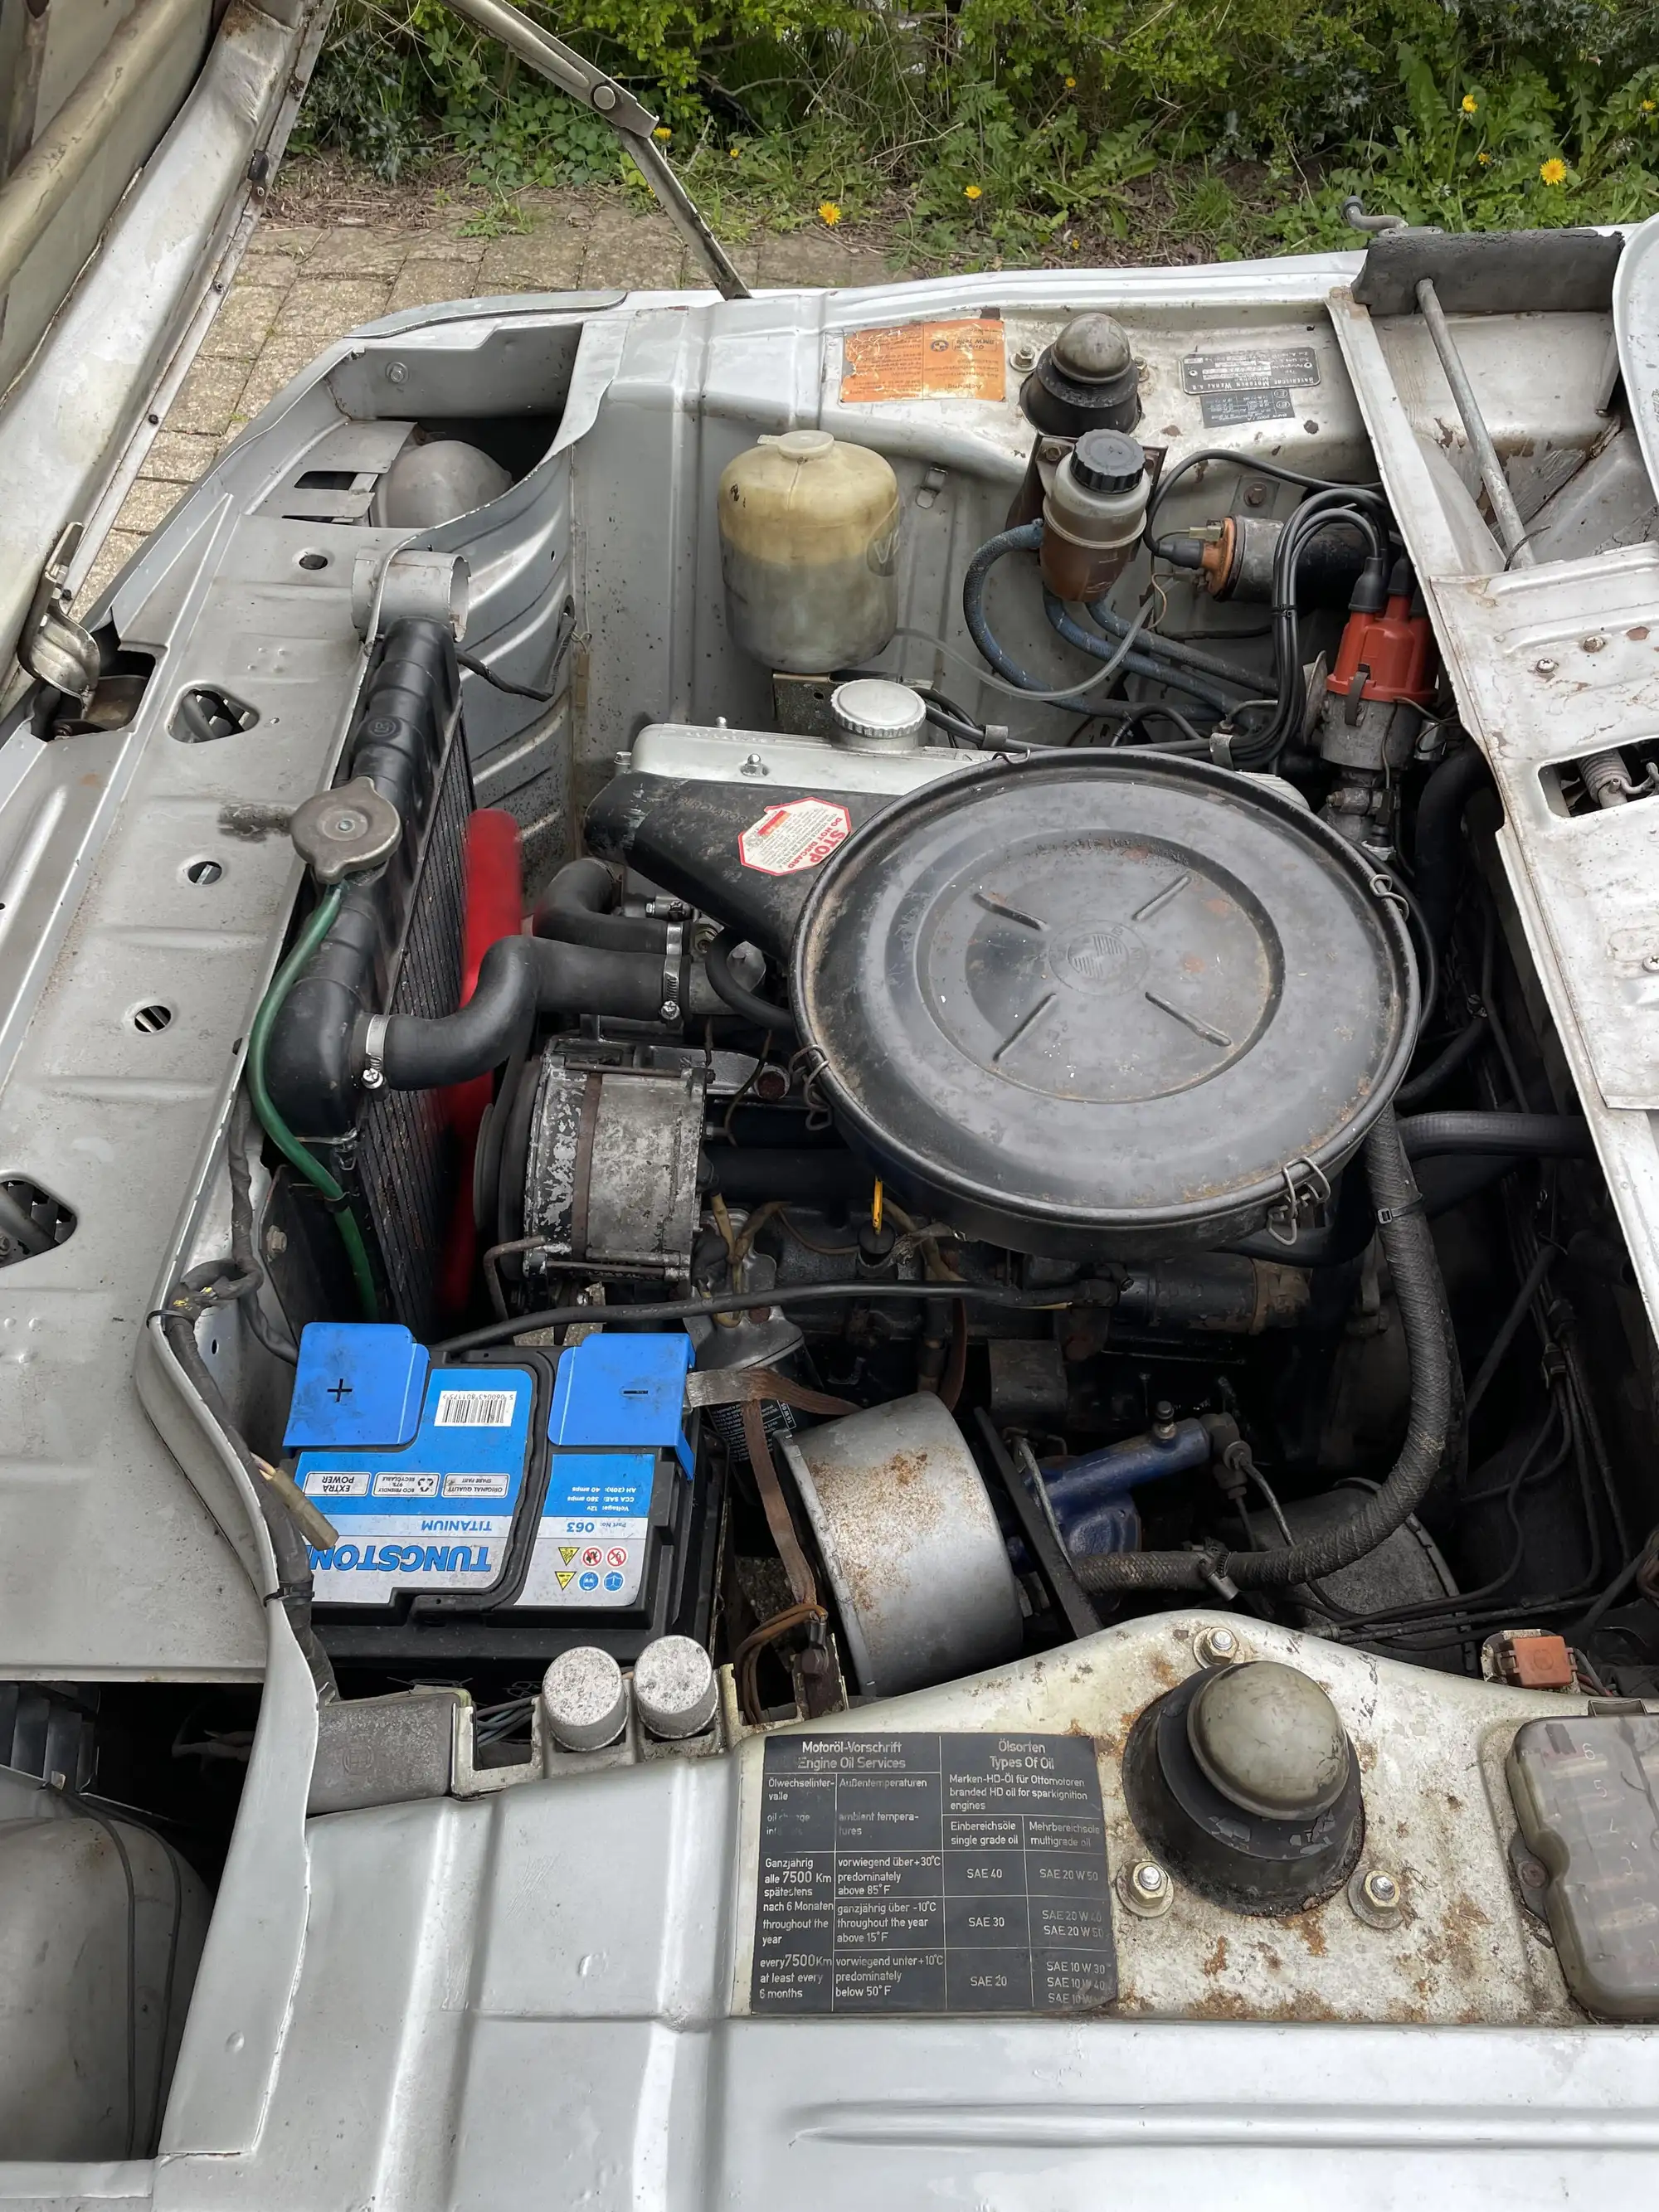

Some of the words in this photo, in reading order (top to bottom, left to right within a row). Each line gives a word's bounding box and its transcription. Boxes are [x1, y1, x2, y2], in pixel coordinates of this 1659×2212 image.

[830, 817, 843, 827] DO
[817, 826, 833, 841] NOT
[809, 829, 846, 863] STOP
[787, 841, 818, 868] DISCARD
[321, 1475, 355, 1484] POWER
[322, 1484, 351, 1493] EXTRA
[421, 1519, 492, 1532] TITANIUM
[304, 1544, 492, 1573] TUNGSTON
[802, 1741, 902, 1753] Motoröl-Vorschrift
[998, 1738, 1046, 1753] Ölsorten
[798, 1757, 837, 1772] Engine
[839, 1757, 854, 1768] Oil
[857, 1757, 906, 1769] Services
[989, 1755, 1023, 1771] Types
[1024, 1756, 1039, 1768] Of
[1039, 1757, 1055, 1770] Oil
[768, 1777, 835, 1788] Ölwechselinter-
[839, 1777, 927, 1789] Außentemperaturen
[949, 1772, 1014, 1784] Marken-HD-Öl
[1016, 1774, 1029, 1784] für
[1030, 1775, 1085, 1787] Ottomotoren
[950, 1787, 987, 1796] branded
[990, 1787, 1004, 1796] HD
[1005, 1787, 1016, 1796] oil
[1018, 1787, 1030, 1796] for
[950, 1800, 986, 1812] engines
[839, 1812, 875, 1821] ambient
[877, 1811, 919, 1823] tempera-
[839, 1826, 863, 1836] tures
[951, 1820, 1016, 1831] Einbereichsöle
[951, 1835, 978, 1847] single
[980, 1836, 1006, 1847] grade
[1008, 1834, 1019, 1845] oil
[1030, 1836, 1078, 1848] multigrade
[1081, 1837, 1092, 1847] oil
[765, 1857, 814, 1870] Ganzjährig
[837, 1856, 891, 1869] vorwiegend
[764, 1873, 781, 1884] alle
[782, 1870, 812, 1884] 7500
[815, 1873, 832, 1884] Km
[837, 1870, 902, 1885] predominately
[966, 1868, 989, 1879] SAE
[990, 1868, 1003, 1879] 40
[1039, 1869, 1061, 1879] SAE
[1063, 1869, 1073, 1880] 20
[1087, 1871, 1099, 1881] 50
[837, 1884, 864, 1895] above
[763, 1902, 785, 1912] nach
[786, 1901, 793, 1911] 6
[794, 1900, 834, 1912] Monaten
[837, 1902, 887, 1916] ganzjährig
[888, 1902, 910, 1913] über
[1041, 1909, 1064, 1920] SAE
[1065, 1910, 1078, 1922] 20
[762, 1918, 812, 1932] throughout
[814, 1918, 829, 1928] the
[837, 1918, 888, 1932] throughout
[890, 1917, 906, 1928] the
[907, 1918, 928, 1930] year
[968, 1917, 990, 1928] SAE
[993, 1917, 1005, 1928] 30
[1043, 1924, 1066, 1936] SAE
[1068, 1926, 1079, 1937] 20
[761, 1934, 783, 1947] year
[836, 1932, 864, 1943] above
[835, 1955, 891, 1969] vorwiegend
[1046, 1961, 1068, 1972] SAE
[1070, 1962, 1080, 1972] 10
[1093, 1963, 1106, 1975] 30
[760, 1972, 771, 1984] at
[771, 1972, 795, 1983] least
[797, 1973, 824, 1985] every
[835, 1970, 902, 1983] predominately
[970, 1976, 993, 1987] SAE
[995, 1974, 1008, 1987] 20
[1047, 1976, 1069, 1988] SAE
[1071, 1977, 1081, 1989] 10
[1093, 1980, 1106, 1991] 40
[767, 1988, 803, 1999] months
[835, 1986, 864, 1998] below
[1048, 1992, 1069, 2004] SAE
